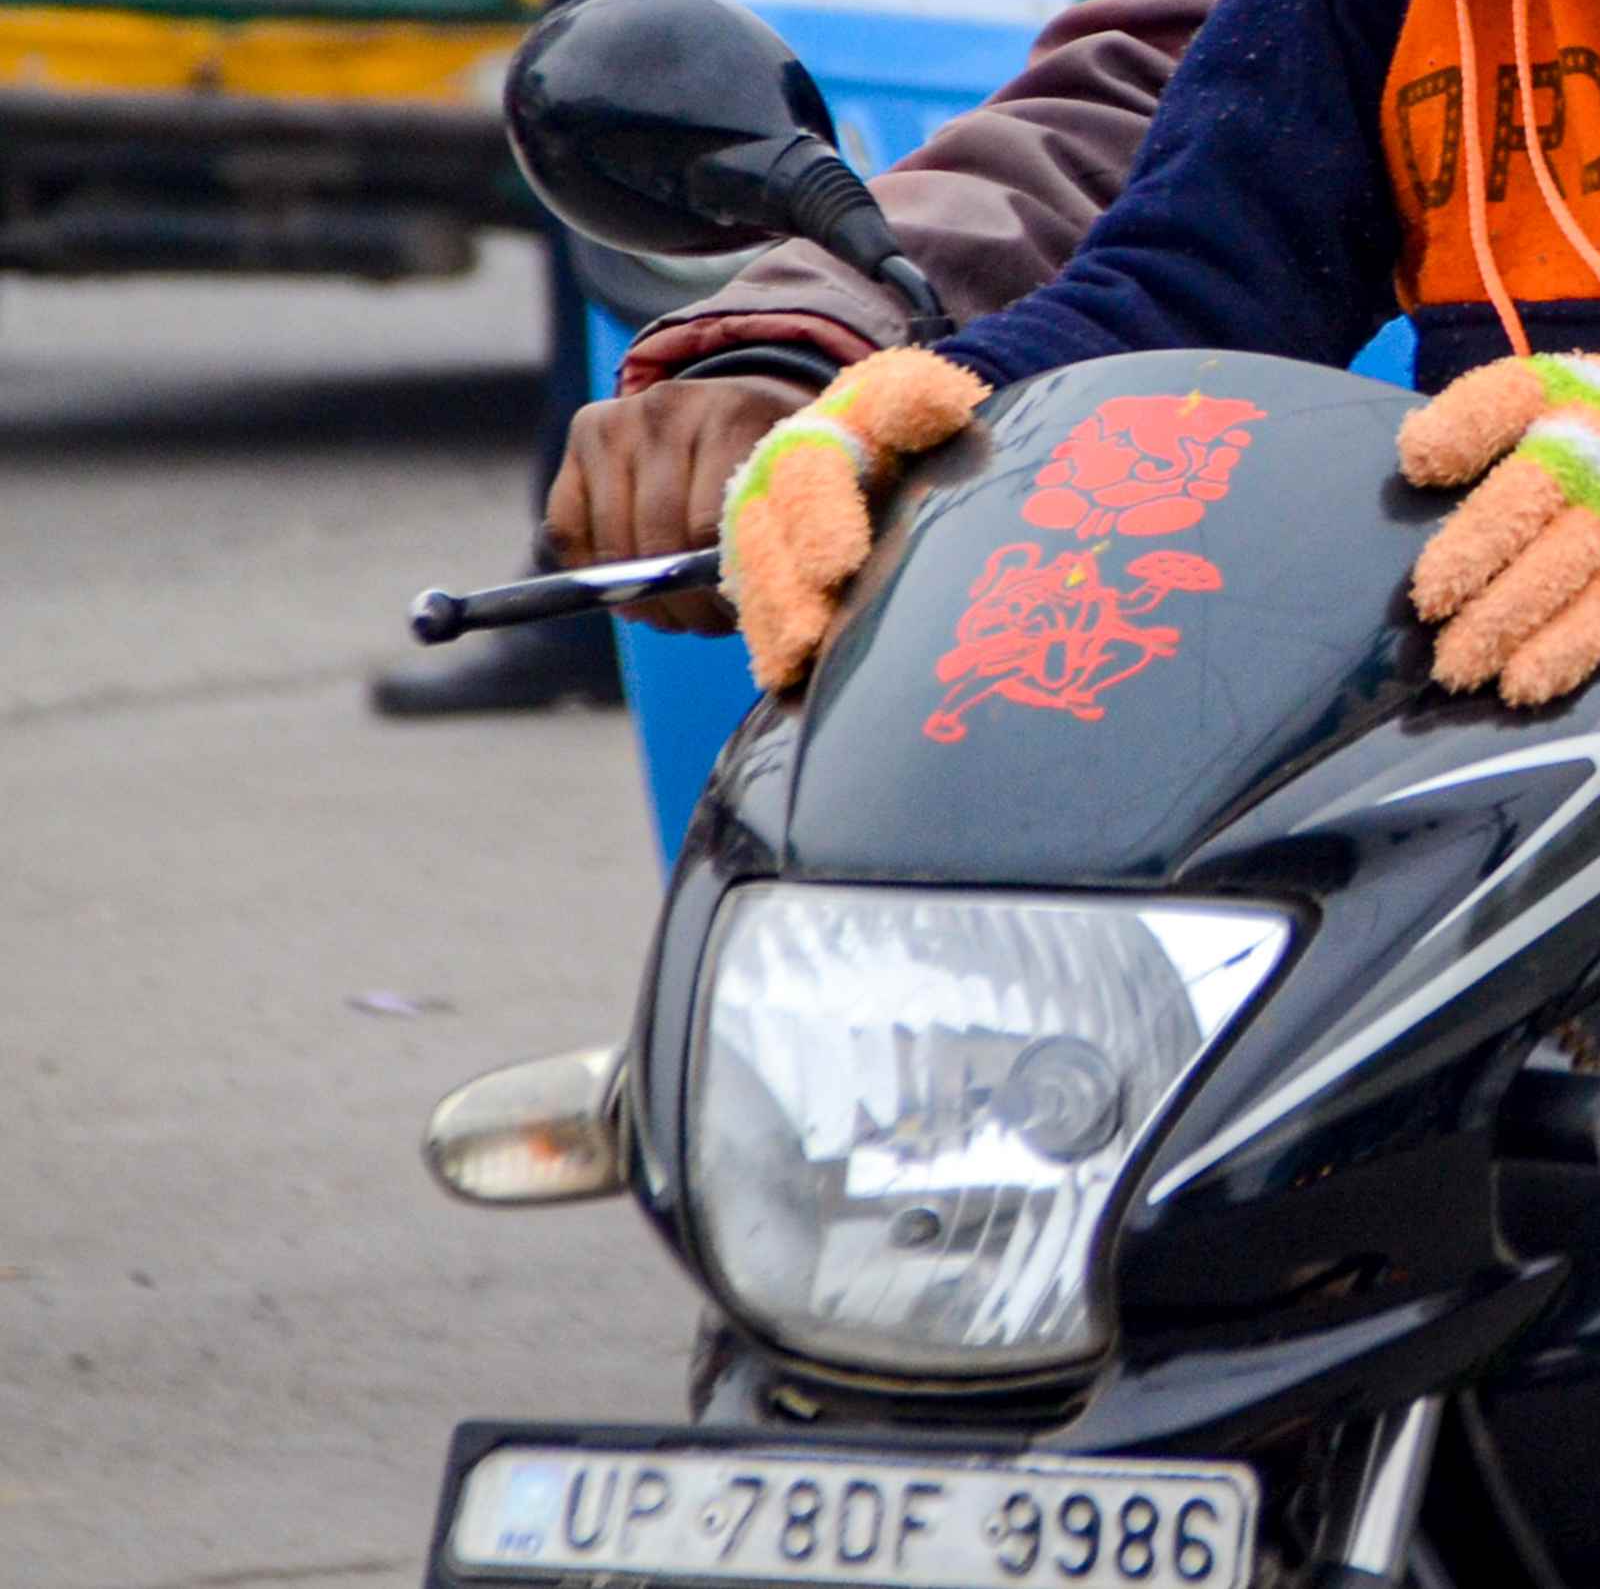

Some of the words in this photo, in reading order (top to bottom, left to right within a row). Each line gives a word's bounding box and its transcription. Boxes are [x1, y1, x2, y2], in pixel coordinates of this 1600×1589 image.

[563, 1467, 673, 1557] UP
[716, 1475, 944, 1568] 78DF
[998, 1491, 1219, 1582] 9986
